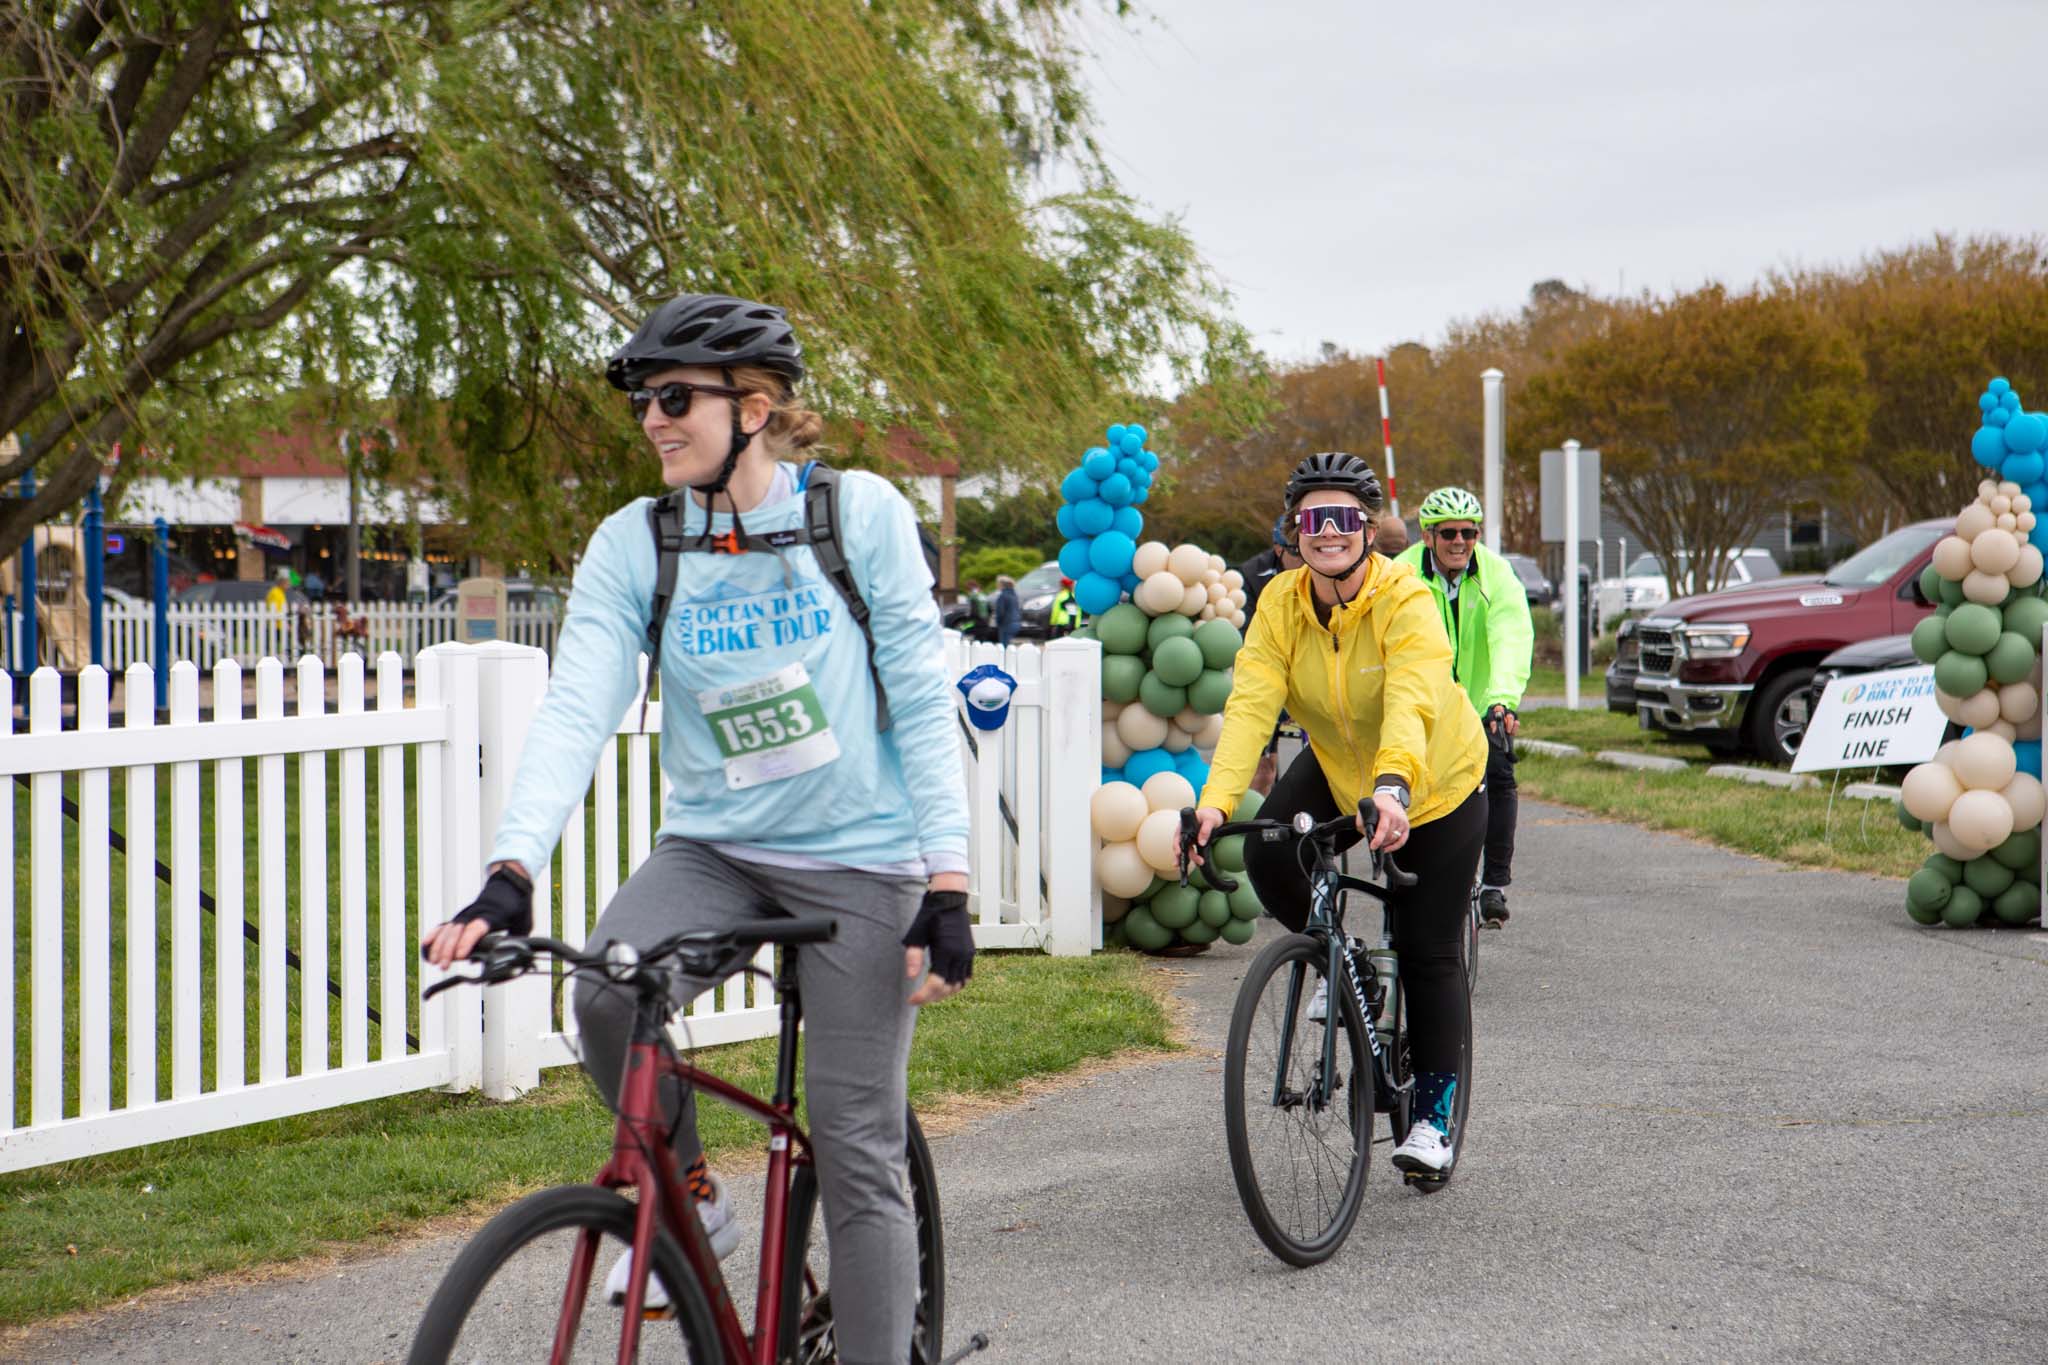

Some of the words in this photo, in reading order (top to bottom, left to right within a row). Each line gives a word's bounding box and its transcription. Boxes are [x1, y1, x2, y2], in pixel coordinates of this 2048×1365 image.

[697, 601, 765, 625] OCEAN
[770, 598, 789, 616] TO
[697, 623, 761, 655] BIKE
[768, 609, 831, 646] TOUR
[1866, 687, 1896, 702] BIKE
[717, 699, 813, 752] 1553
[1843, 706, 1912, 730] FINISH
[1842, 739, 1889, 760] LINE
[1342, 945, 1381, 1056] SPECIALIZED
